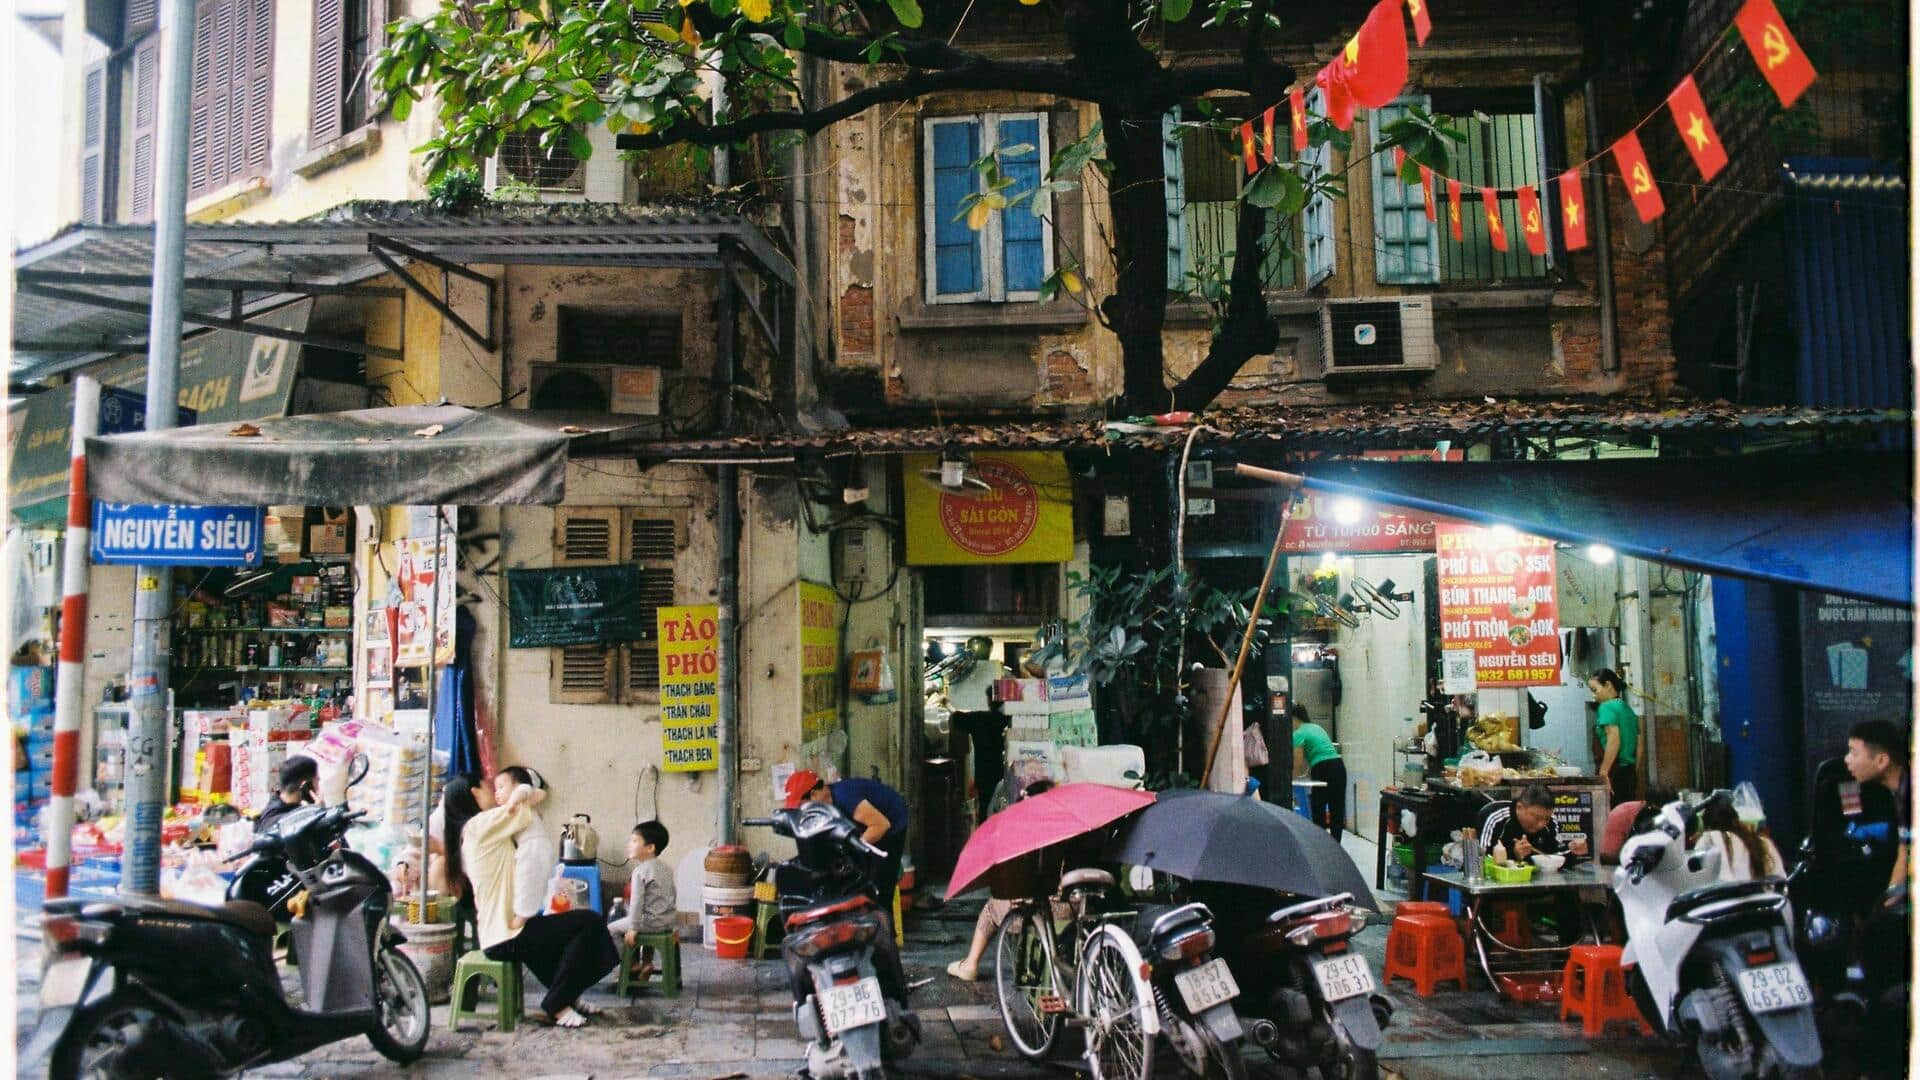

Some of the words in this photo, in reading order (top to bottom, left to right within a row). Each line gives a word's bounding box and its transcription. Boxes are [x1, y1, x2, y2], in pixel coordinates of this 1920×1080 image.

[104, 508, 194, 549] NGUYỄN
[201, 514, 251, 550] SIÊU
[1385, 520, 1433, 536] SÁNG
[1526, 554, 1552, 572] 35K
[1442, 585, 1470, 606] BÚN
[1473, 586, 1517, 604] THANG
[1528, 585, 1552, 602] 40K
[664, 613, 717, 642] TÀO
[1444, 614, 1470, 640] PHỞ
[1474, 616, 1510, 641] TRỘN
[1530, 618, 1554, 636] 40K
[666, 645, 718, 676] PHỚ
[1479, 651, 1526, 668] NGUYỄN
[1530, 652, 1556, 666] SIÊU
[1508, 668, 1554, 680] 681957
